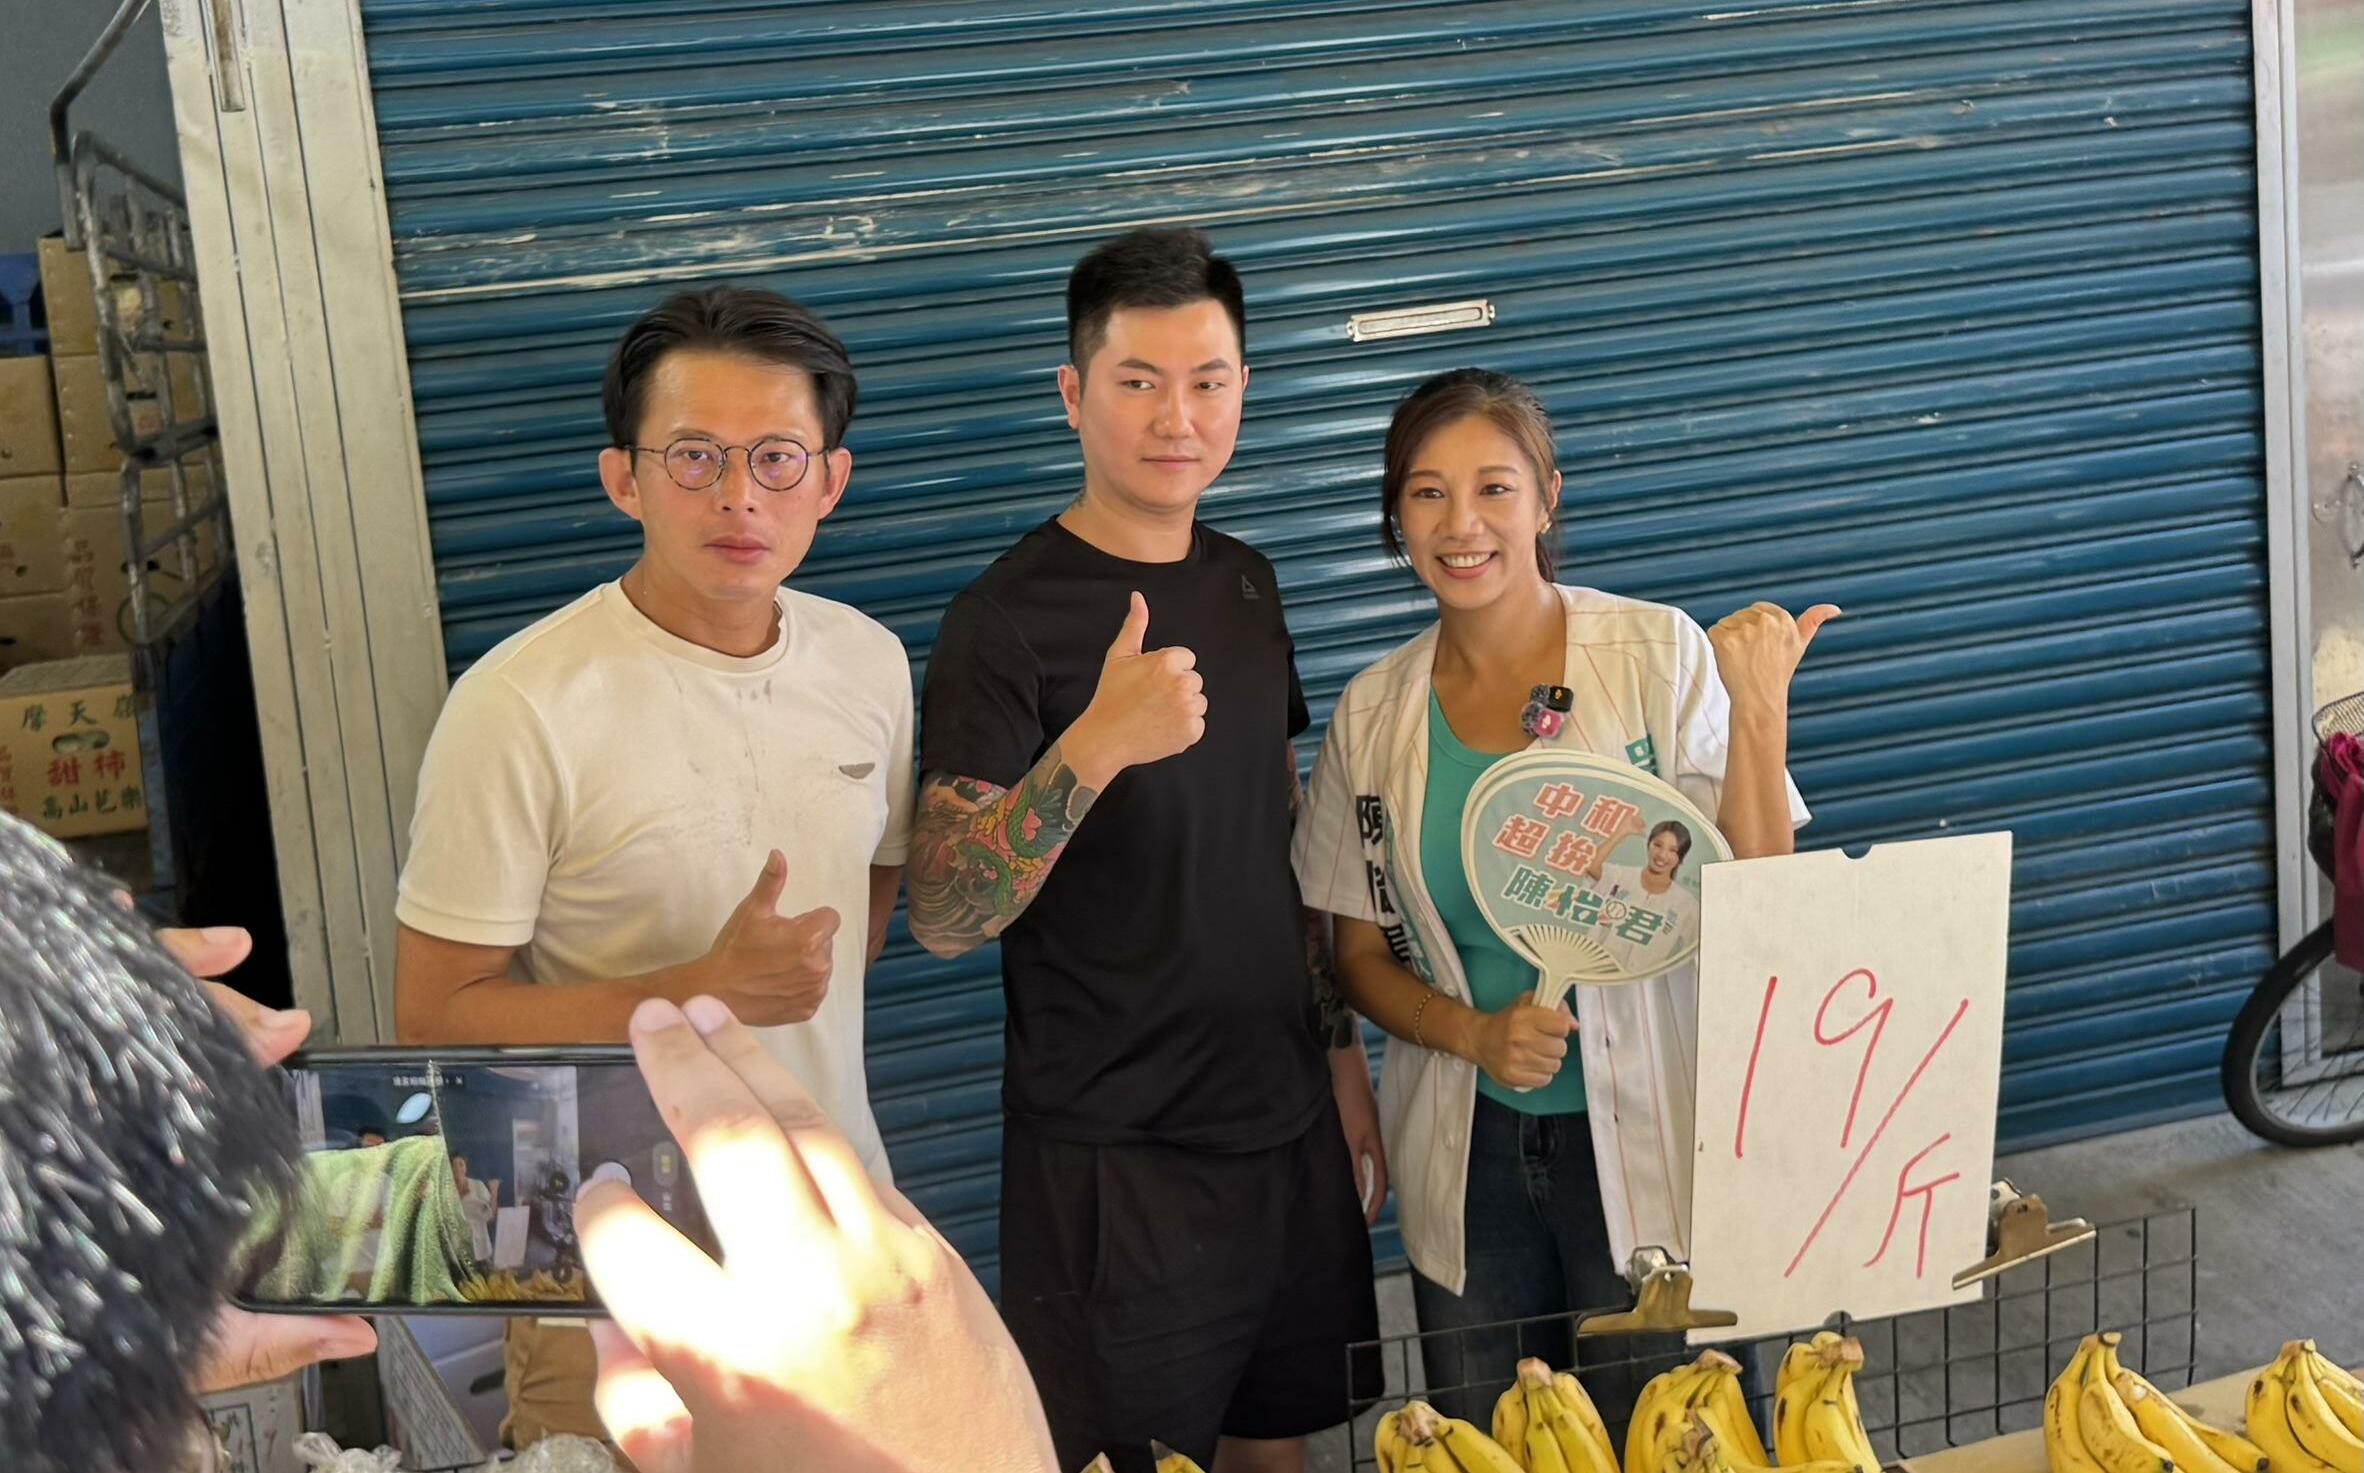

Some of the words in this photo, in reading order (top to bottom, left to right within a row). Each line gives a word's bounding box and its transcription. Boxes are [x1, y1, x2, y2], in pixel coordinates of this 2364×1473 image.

[1533, 782, 1640, 838] 中和
[1502, 864, 1665, 946] 陳怡君
